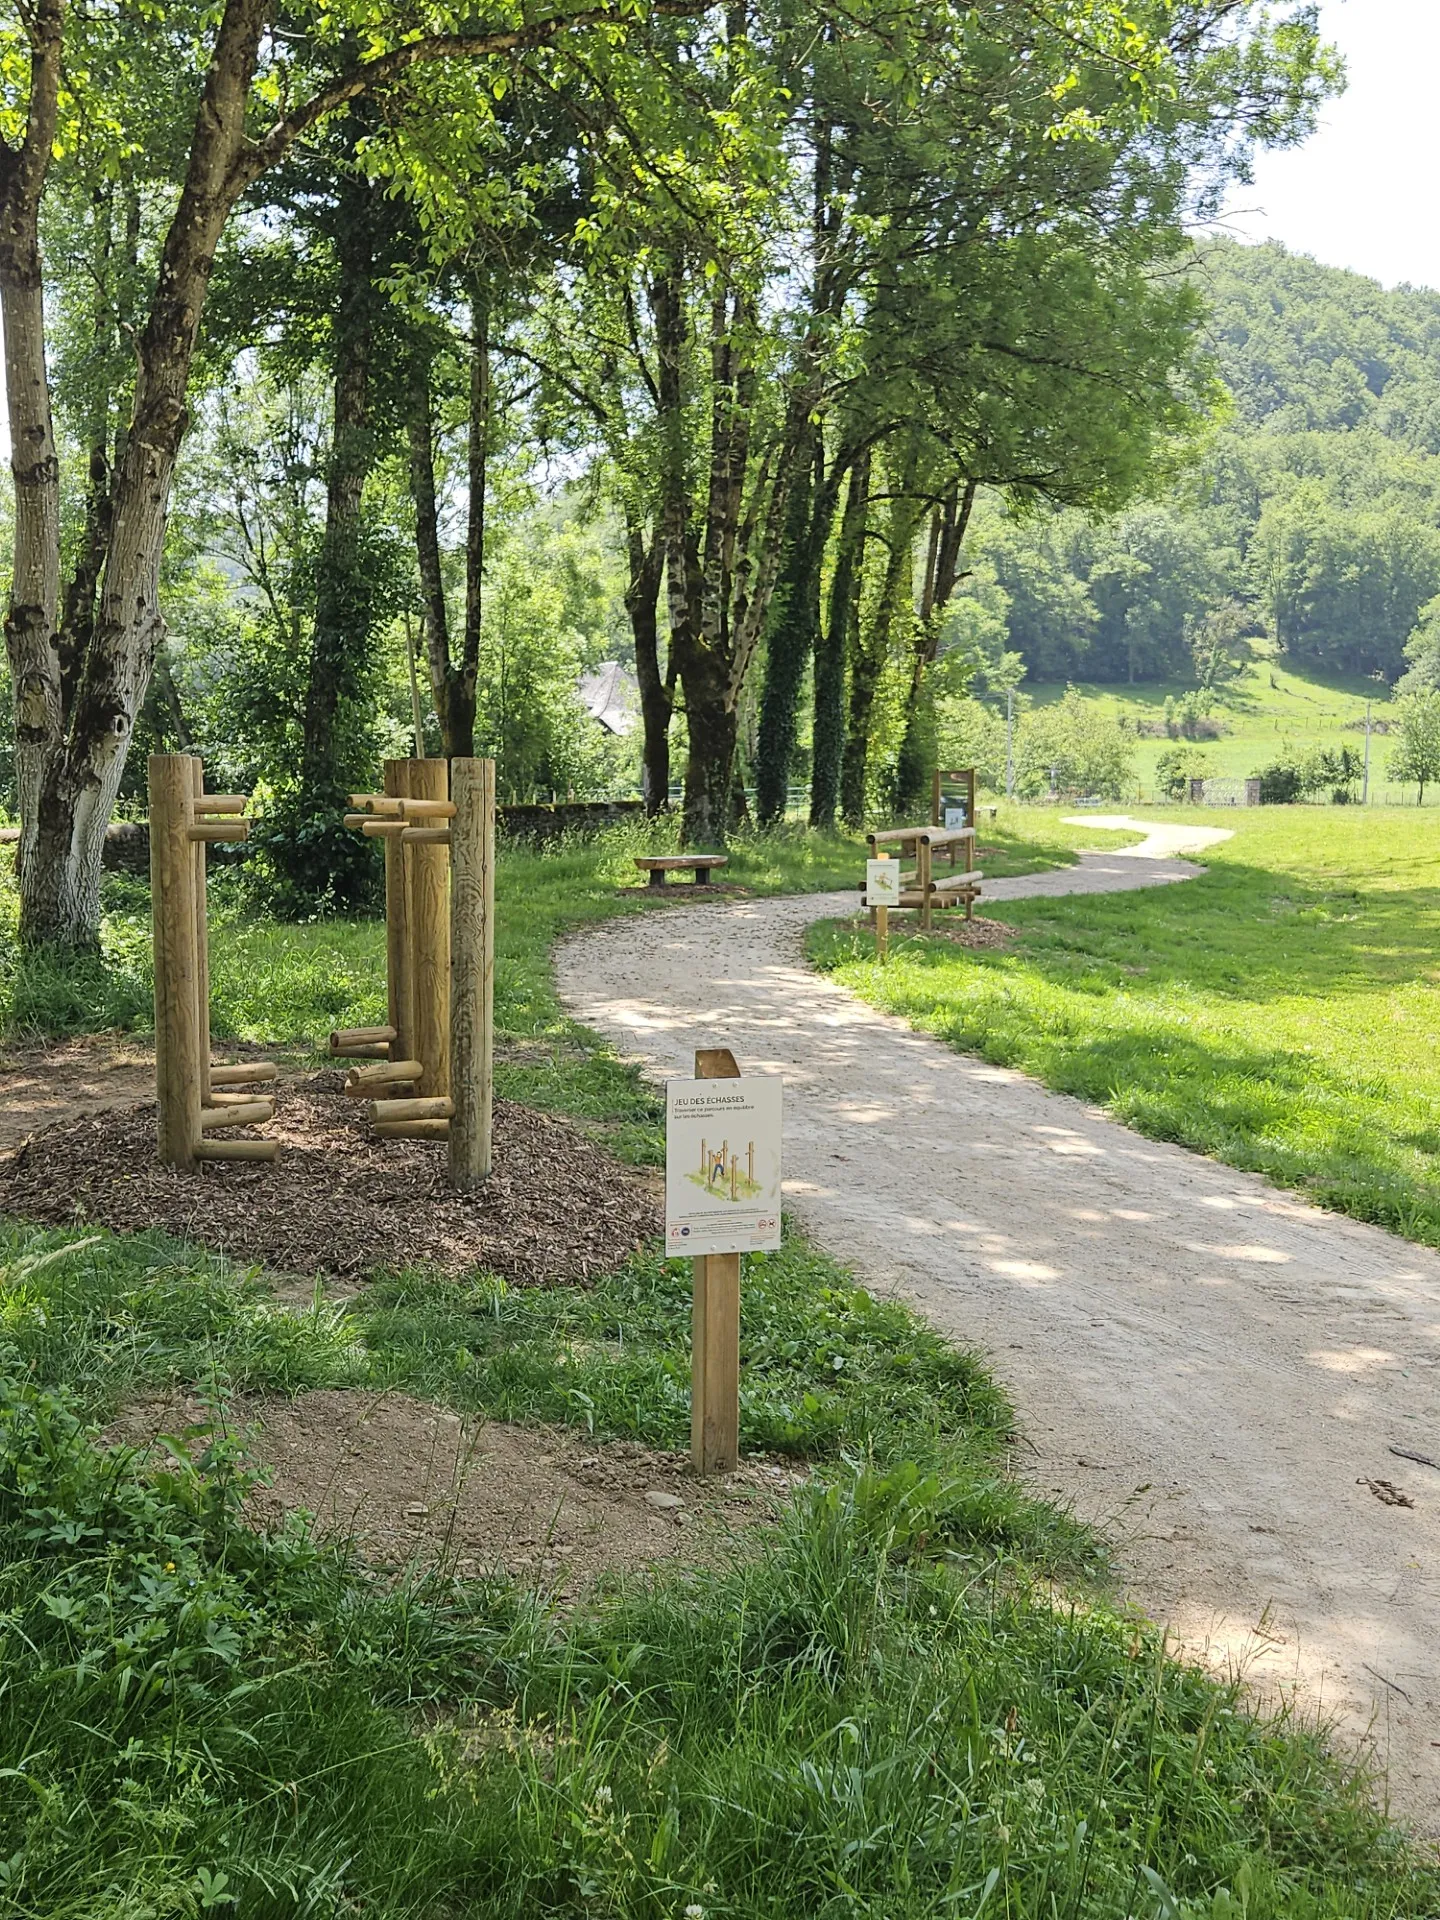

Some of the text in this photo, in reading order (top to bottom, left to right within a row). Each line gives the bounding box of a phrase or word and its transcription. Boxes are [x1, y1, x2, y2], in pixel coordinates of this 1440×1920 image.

[674, 1095, 745, 1106] JEU DES ÉCHASSES
